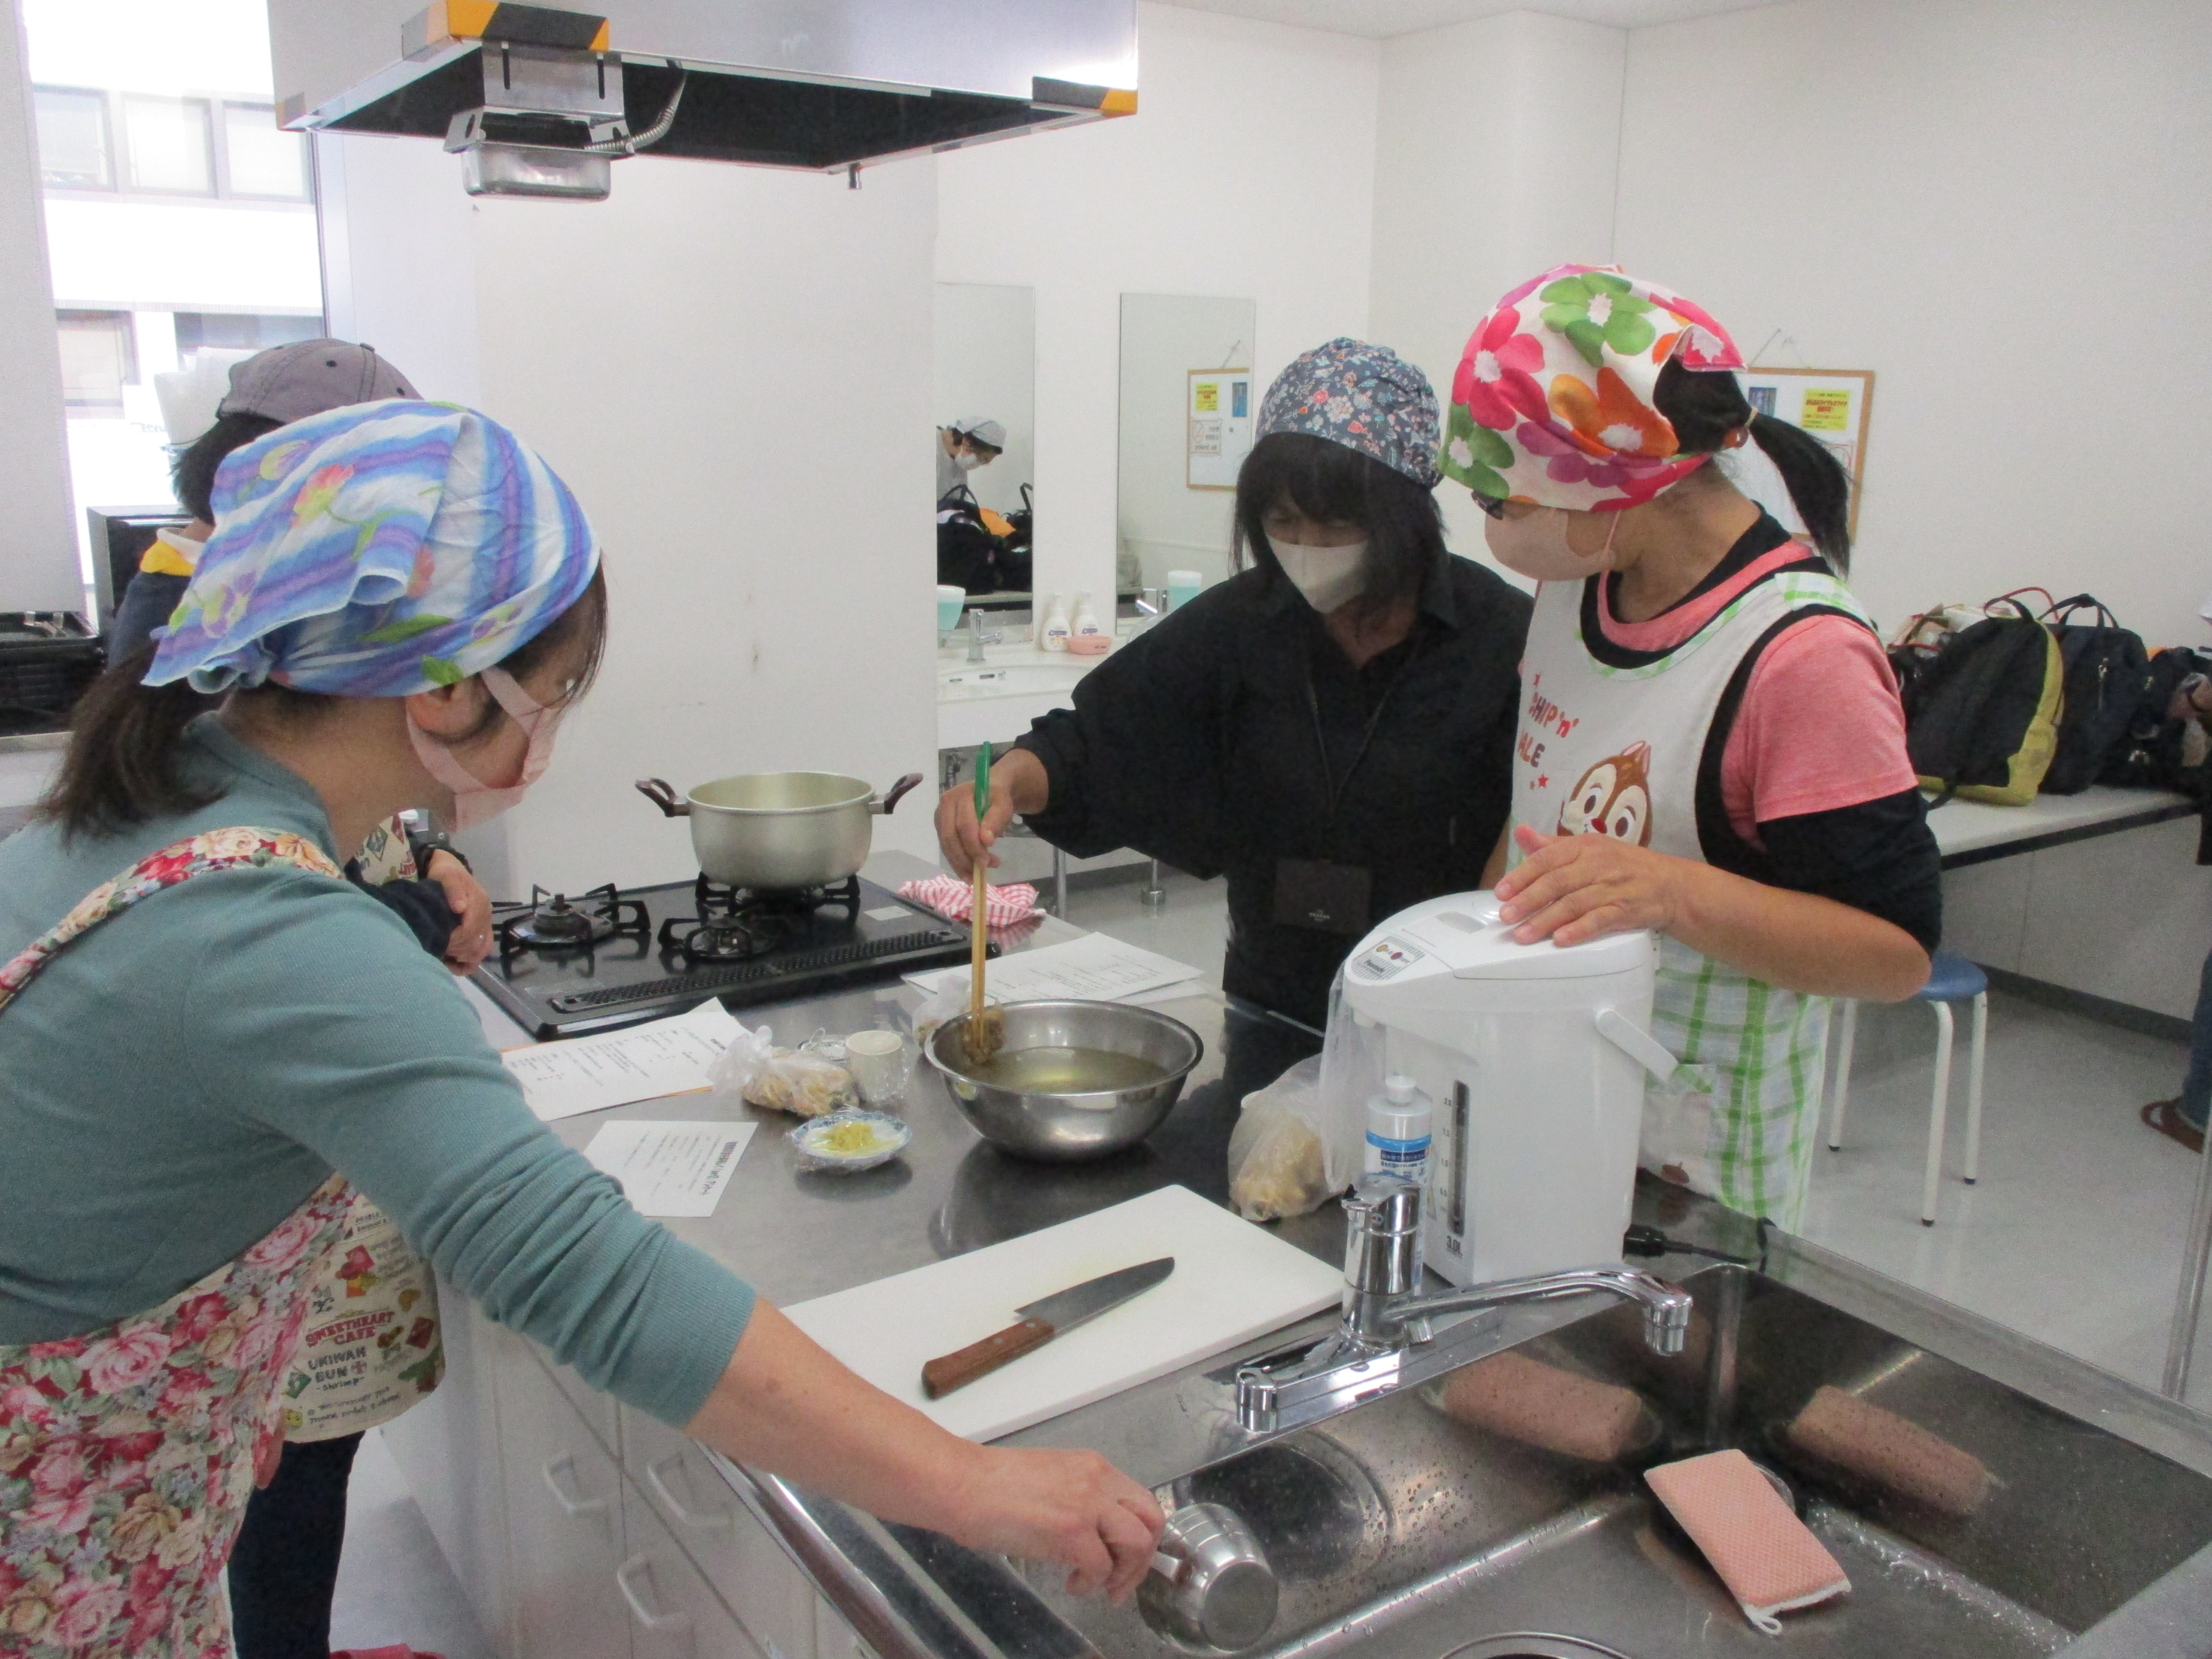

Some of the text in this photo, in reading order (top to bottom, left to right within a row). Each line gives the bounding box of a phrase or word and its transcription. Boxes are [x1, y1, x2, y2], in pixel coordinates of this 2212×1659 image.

[1446, 1235, 1463, 1256] 3.0L
[305, 1311, 395, 1347] SWEETHEART
[334, 1326, 376, 1345] CAFE
[315, 1366, 348, 1382] BUN
